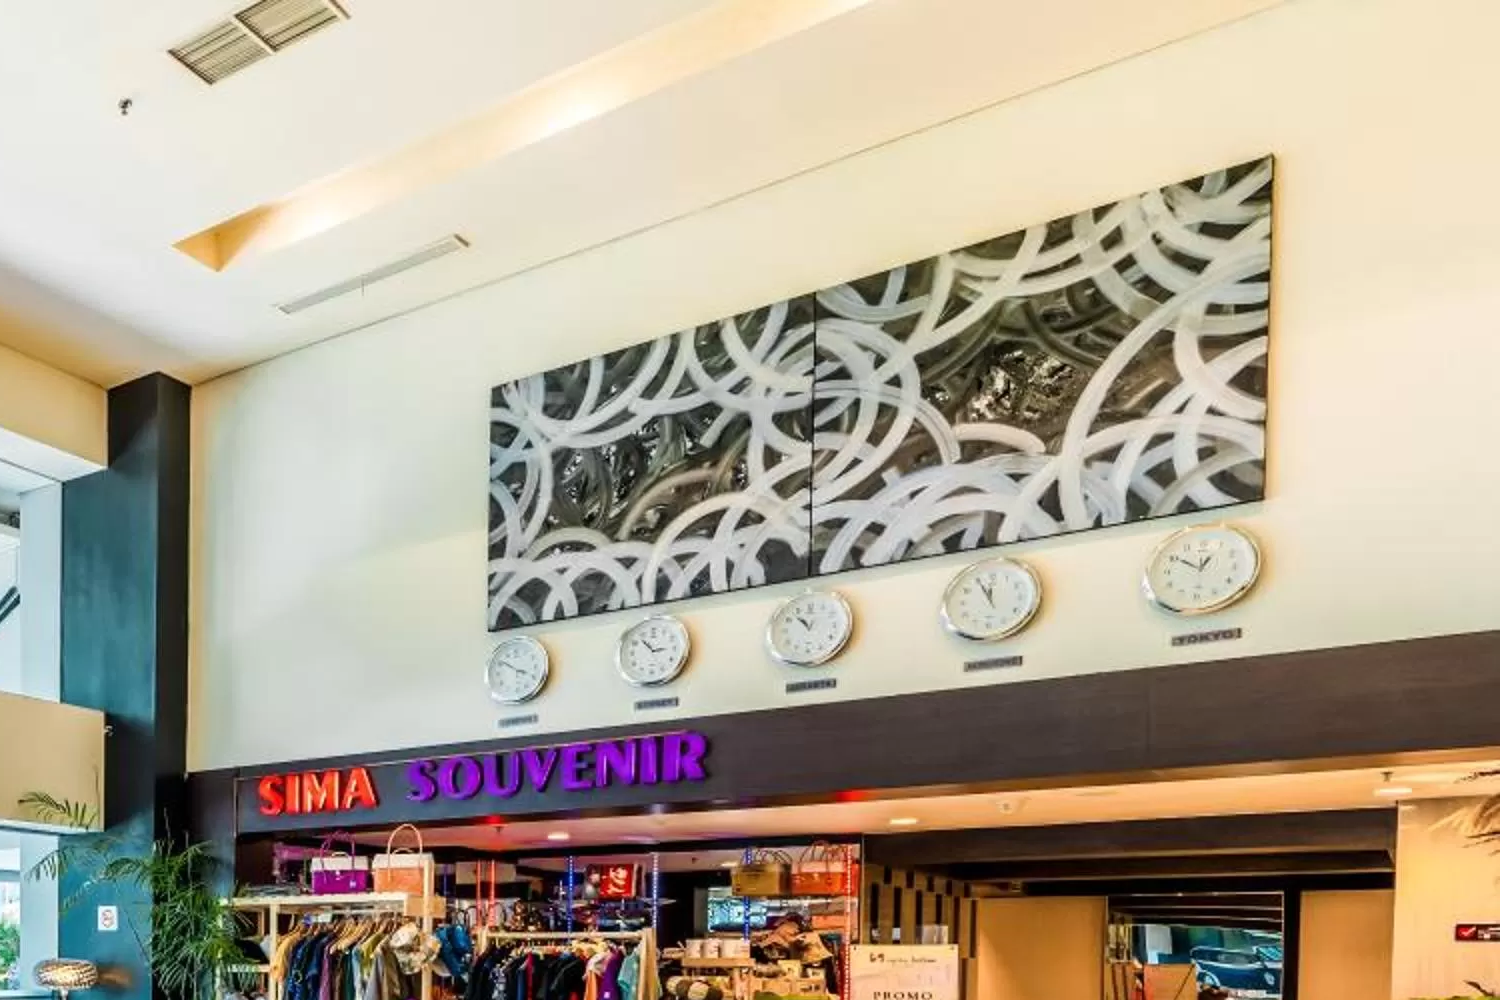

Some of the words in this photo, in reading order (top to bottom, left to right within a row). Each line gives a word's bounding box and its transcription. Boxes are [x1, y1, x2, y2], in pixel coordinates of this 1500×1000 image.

[258, 767, 378, 816] SIMA
[405, 729, 709, 802] SOUVENIR
[873, 991, 933, 1000] PROMO
